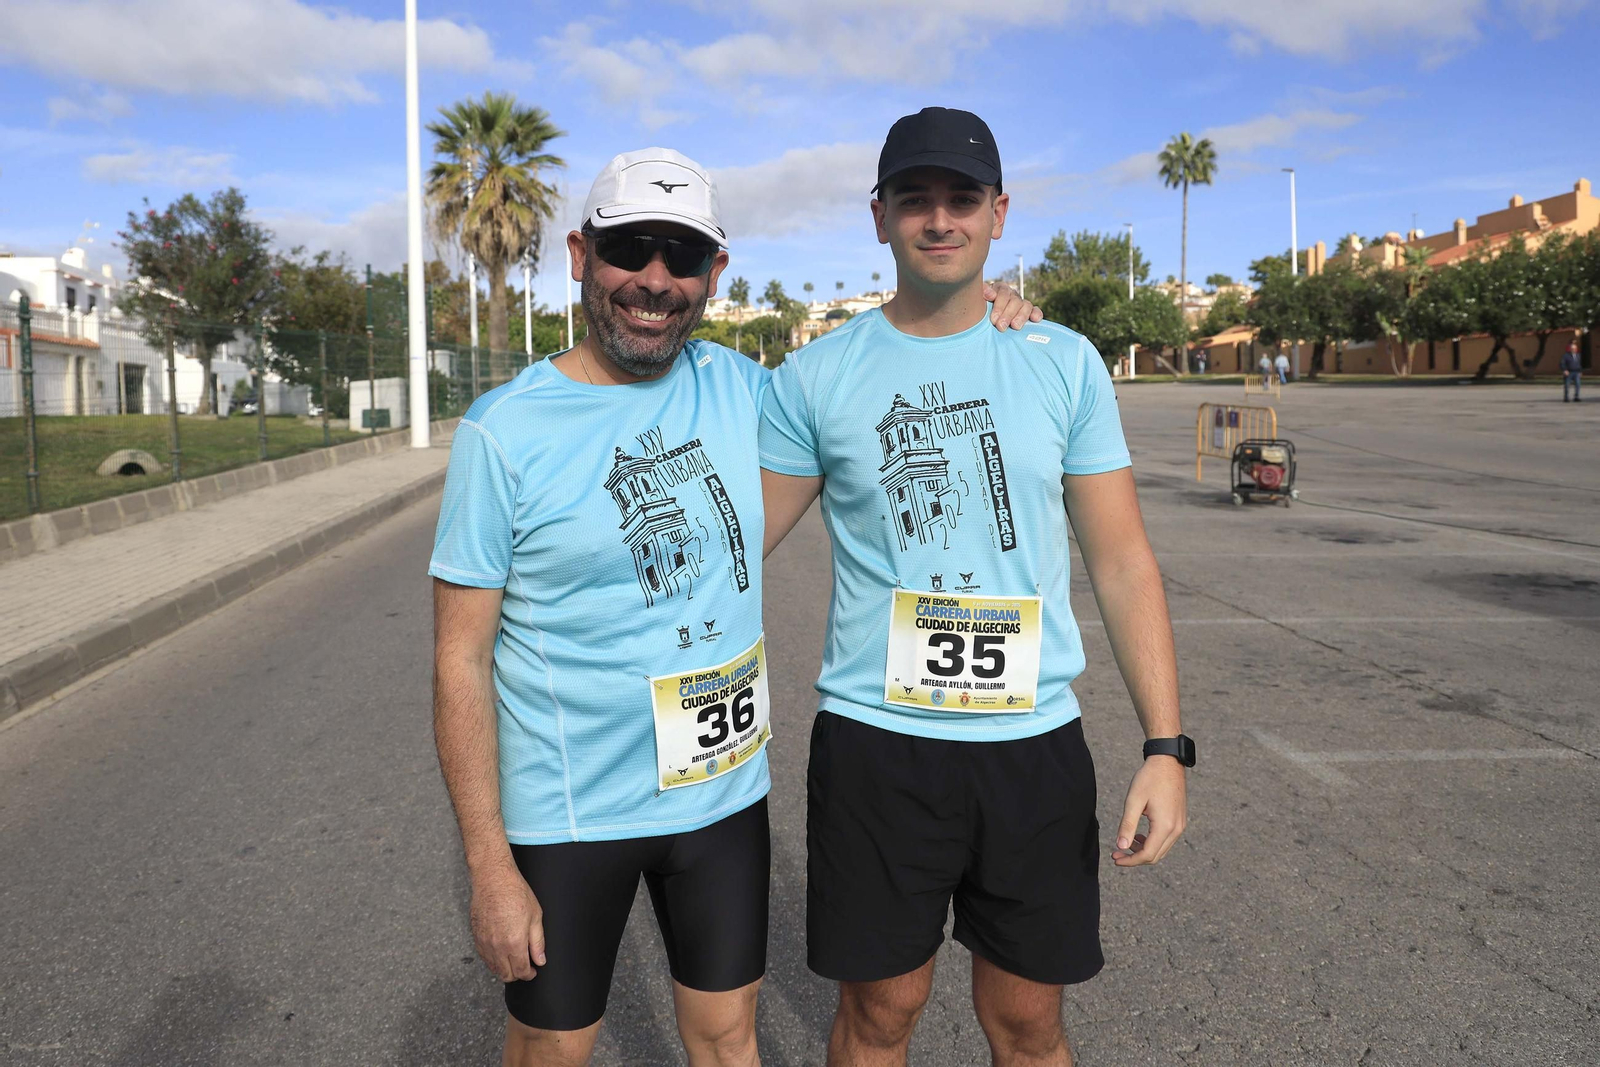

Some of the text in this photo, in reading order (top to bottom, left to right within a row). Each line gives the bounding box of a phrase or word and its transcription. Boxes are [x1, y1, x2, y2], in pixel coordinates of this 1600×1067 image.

[919, 381, 947, 409] XXV
[933, 398, 990, 415] CARRERA
[933, 408, 995, 439] URBANA
[635, 425, 665, 457] XXV
[655, 438, 703, 464] CARRERA
[657, 449, 715, 488] URBANA
[982, 435, 1014, 548] ALGECIRAS
[707, 477, 749, 589] ALGECIRAS
[916, 605, 1020, 622] CARRERA URBANA
[917, 596, 960, 607] XXV EDICIÓN
[916, 618, 1020, 634] CIUDAD DE ALGECIRAS
[926, 632, 1006, 678] 35
[678, 677, 730, 698] CARRERA
[730, 655, 758, 683] URBANA
[680, 670, 721, 686] XXV EDICIÓN
[682, 666, 759, 710] CIUDAD DE ALGECIRAS
[920, 678, 1006, 690] ARTEAGA AYLLÓN, GUILLERMO
[697, 686, 754, 748] 36
[692, 751, 716, 764] ARTEAGA
[716, 739, 740, 756] GONZÁLEZ,
[740, 725, 758, 744] GUILLERMO
